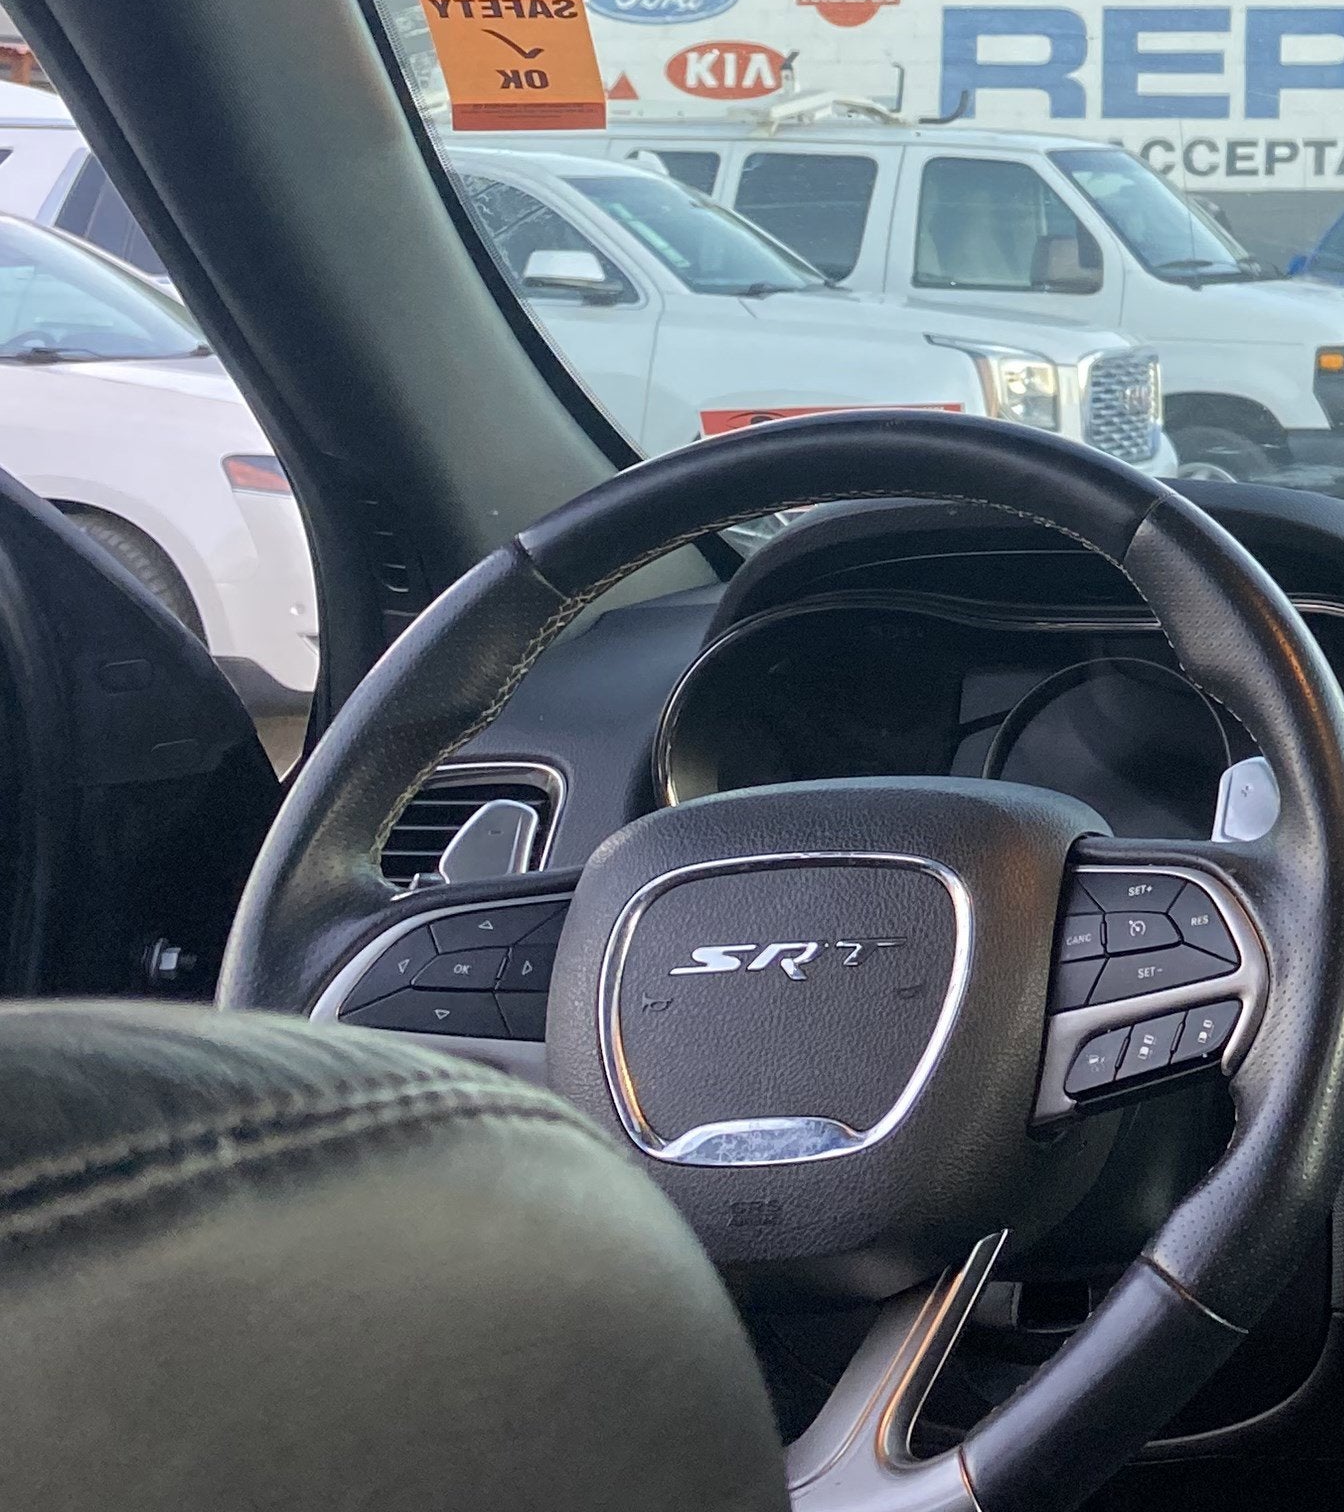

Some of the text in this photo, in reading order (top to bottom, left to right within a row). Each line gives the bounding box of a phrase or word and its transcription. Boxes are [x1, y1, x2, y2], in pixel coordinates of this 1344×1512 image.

[684, 50, 778, 89] KIA
[1190, 916, 1209, 926] RES
[1066, 933, 1092, 946] CANC
[453, 963, 471, 975] OK
